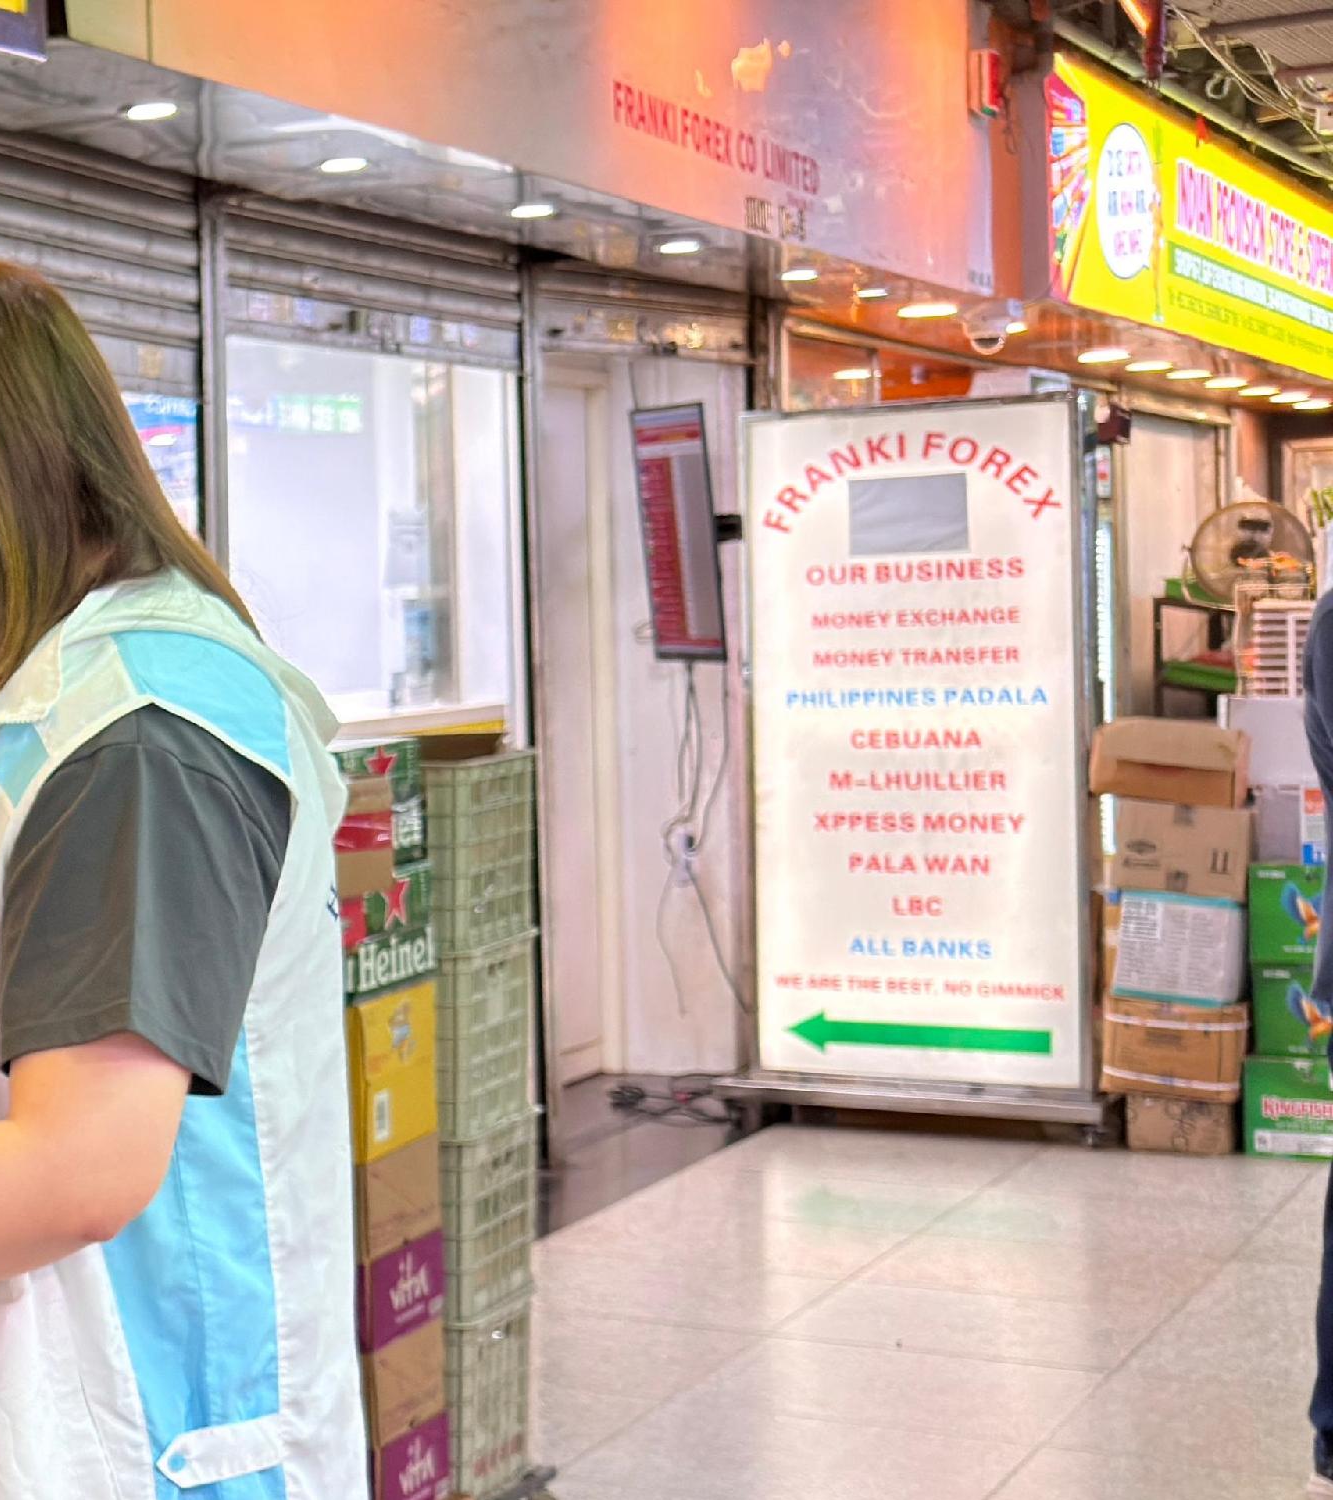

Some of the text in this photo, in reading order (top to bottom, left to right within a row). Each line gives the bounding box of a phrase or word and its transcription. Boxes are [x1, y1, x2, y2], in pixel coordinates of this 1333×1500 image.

[612, 79, 820, 195] FRANKI FOREX CO LIMITED
[762, 431, 1062, 535] FRANKI FOREX
[805, 556, 1026, 586] OUR BUSINESS
[810, 606, 1021, 630] MONEY EXCHANGE
[812, 645, 1021, 668] MONEY TRANSFER
[786, 685, 1048, 709] PHILIPPINES PADALA
[849, 728, 983, 750] CEBUANA
[922, 810, 1025, 834] MONEY
[847, 852, 991, 876] PALA WAN
[891, 895, 944, 917] LBC
[849, 936, 993, 960] ALL BANKS
[775, 974, 802, 989] WE
[806, 974, 842, 991] ARE
[848, 976, 881, 993] THE
[944, 980, 972, 997] NO
[977, 983, 1065, 1001] GIMMICK
